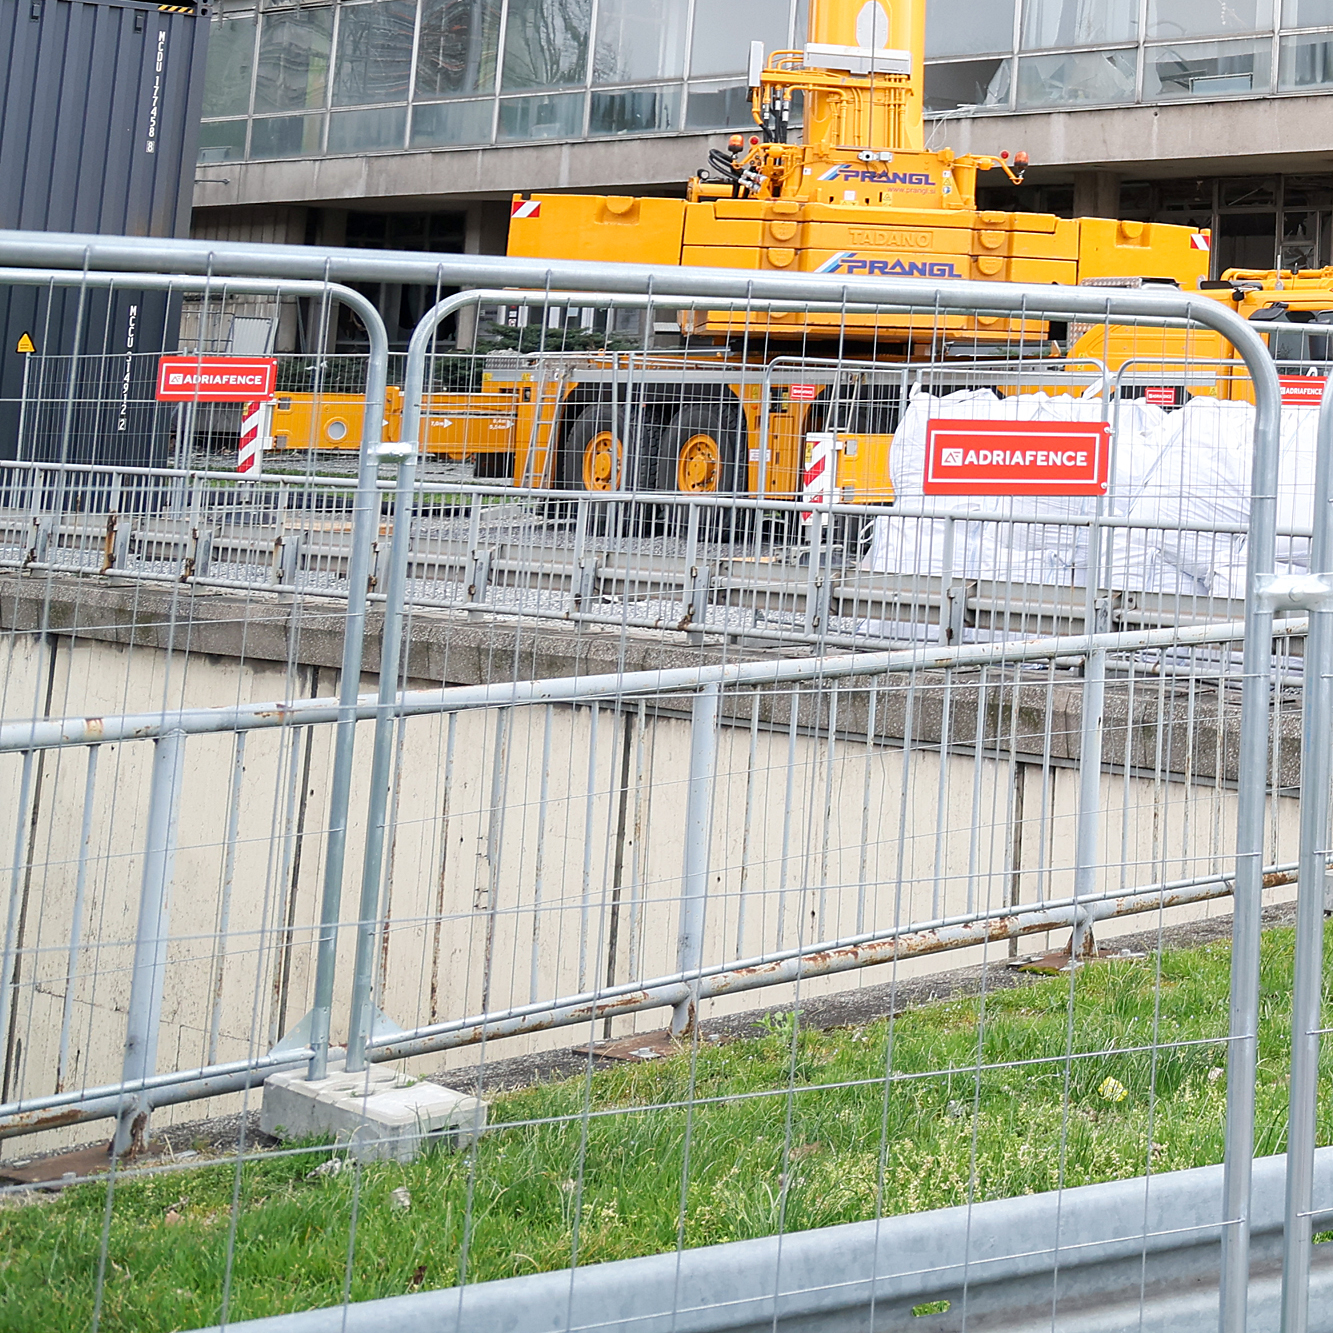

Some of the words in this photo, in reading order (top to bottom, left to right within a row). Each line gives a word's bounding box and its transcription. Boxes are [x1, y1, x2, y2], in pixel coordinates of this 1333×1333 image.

[155, 30, 166, 72] MCDU
[148, 75, 160, 138] 177458
[838, 169, 937, 186] PRANGL
[849, 230, 930, 249] TADANO
[840, 258, 963, 278] PRANGL
[126, 305, 137, 348] MCCU
[183, 374, 262, 385] ADRIAFENCE
[1285, 386, 1323, 395] ADRIAFENCE
[964, 450, 1088, 467] ADRIAFENCE
